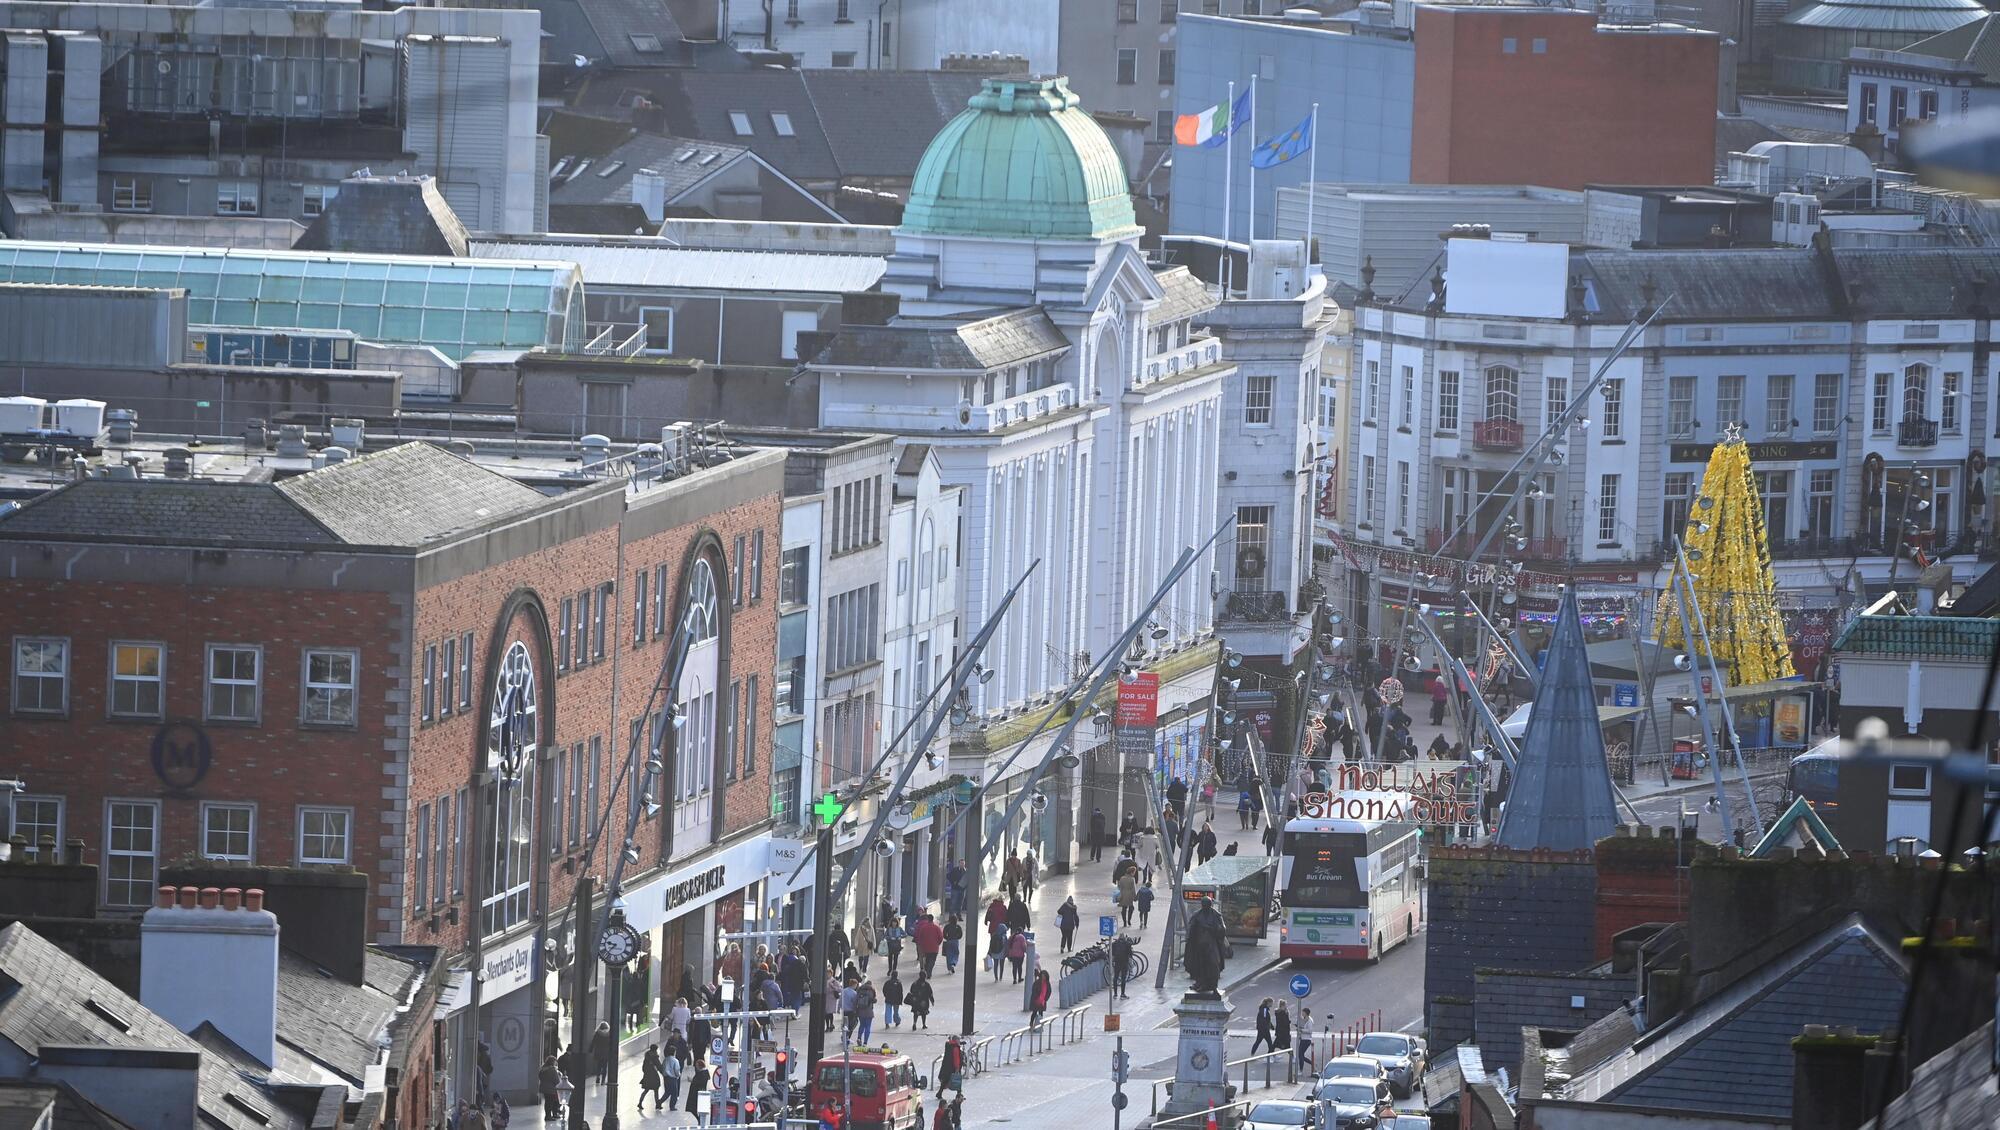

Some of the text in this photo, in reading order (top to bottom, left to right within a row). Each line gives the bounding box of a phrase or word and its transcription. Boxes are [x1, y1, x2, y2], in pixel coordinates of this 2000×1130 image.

[1803, 634, 1826, 646] 60%
[1802, 646, 1825, 658] OFF
[1255, 713, 1271, 721] 60%
[775, 849, 796, 859] M&S
[487, 948, 529, 980] Merchants Quay
